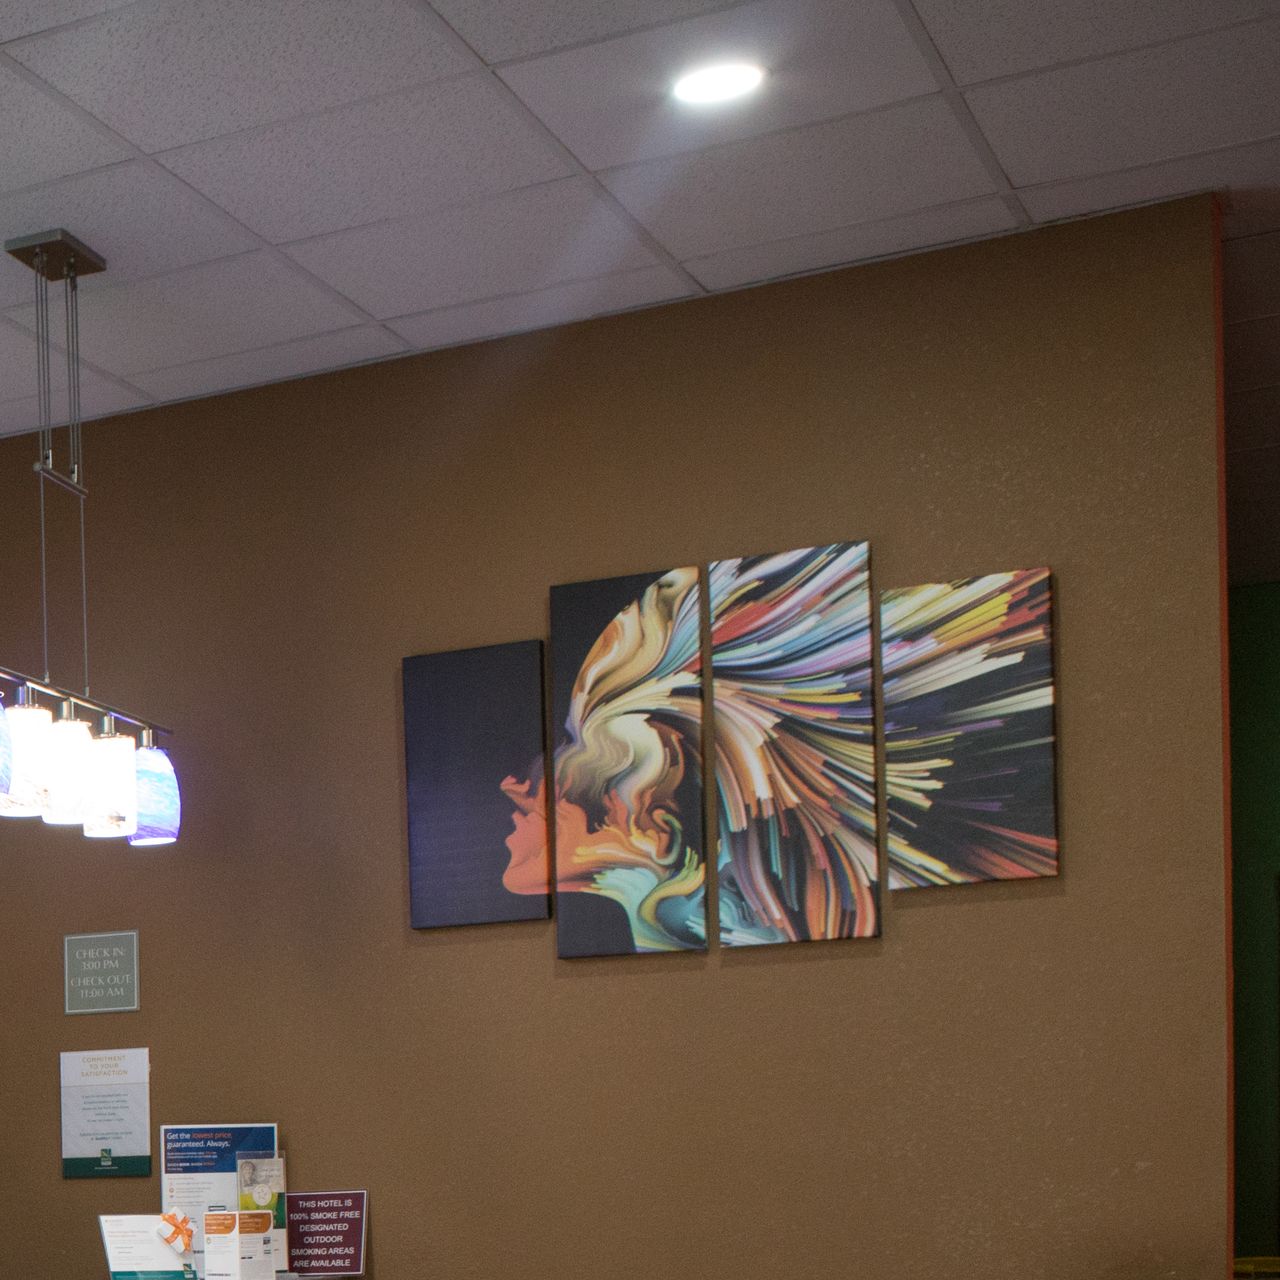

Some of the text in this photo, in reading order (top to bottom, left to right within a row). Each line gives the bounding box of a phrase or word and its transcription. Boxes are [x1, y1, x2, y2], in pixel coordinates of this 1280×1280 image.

[76, 948, 110, 959] CHECK
[103, 960, 119, 969] PM
[71, 976, 104, 987] CHECK
[107, 987, 124, 997] AM
[166, 1132, 179, 1140] Get
[299, 1200, 317, 1208] THIS
[345, 1199, 353, 1207] IS
[310, 1212, 338, 1220] SMOKE
[299, 1223, 349, 1232] DESIGNATED
[303, 1235, 344, 1244] OUTDOOR
[291, 1247, 355, 1256] SMOKING AREAS
[293, 1259, 351, 1268] ARE AVAILABLE
